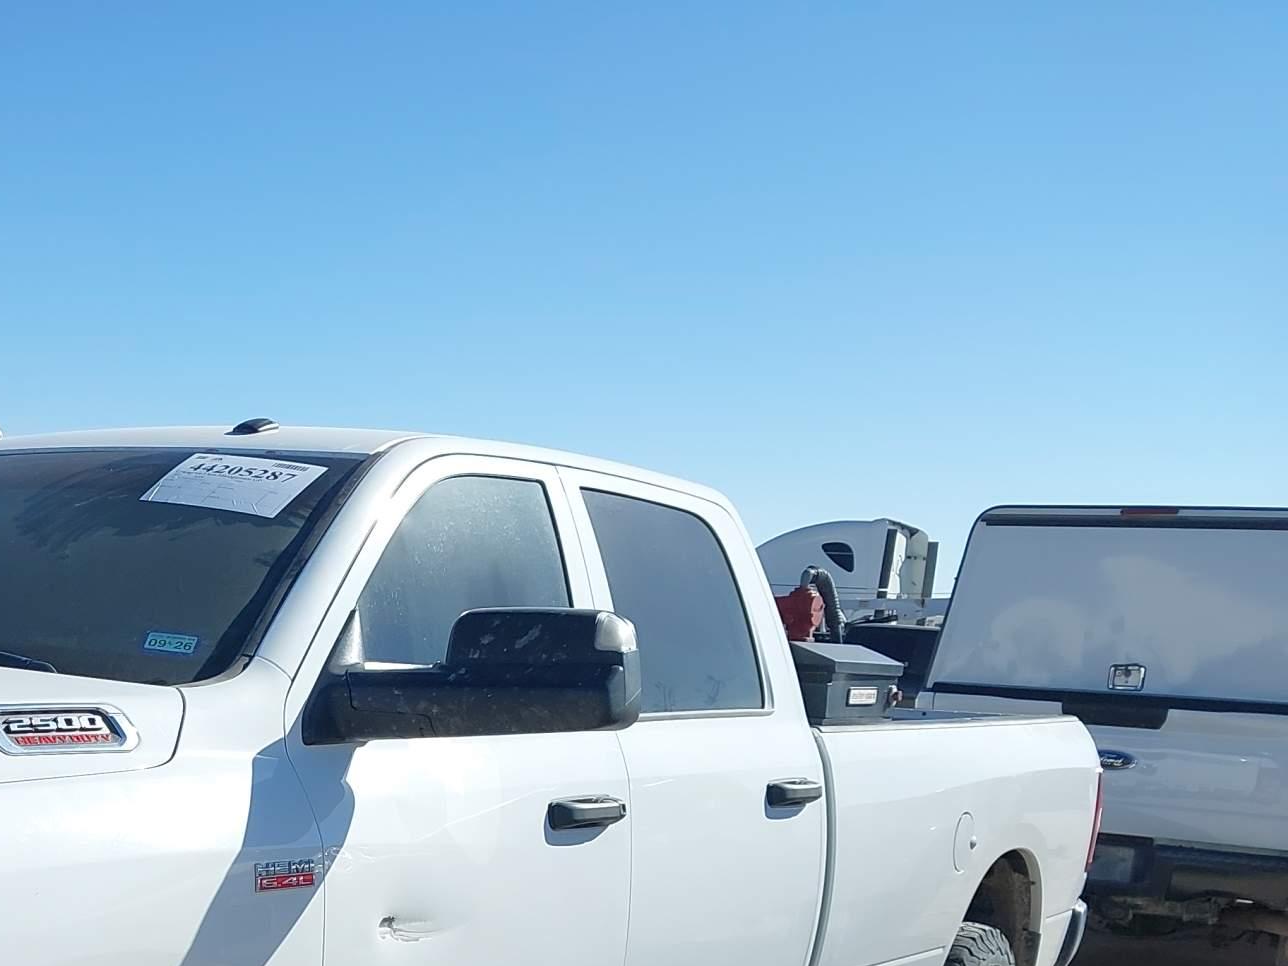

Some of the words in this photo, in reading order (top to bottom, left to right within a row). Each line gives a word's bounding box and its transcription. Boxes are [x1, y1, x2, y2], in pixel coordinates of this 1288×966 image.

[189, 462, 298, 483] 44205287
[148, 638, 167, 648] 09
[174, 641, 194, 651] 26
[2, 713, 105, 734] 2500
[14, 735, 70, 746] HEAVY
[71, 734, 112, 745] DUTY
[255, 860, 315, 877] HEMI
[261, 875, 314, 890] 6.4L
